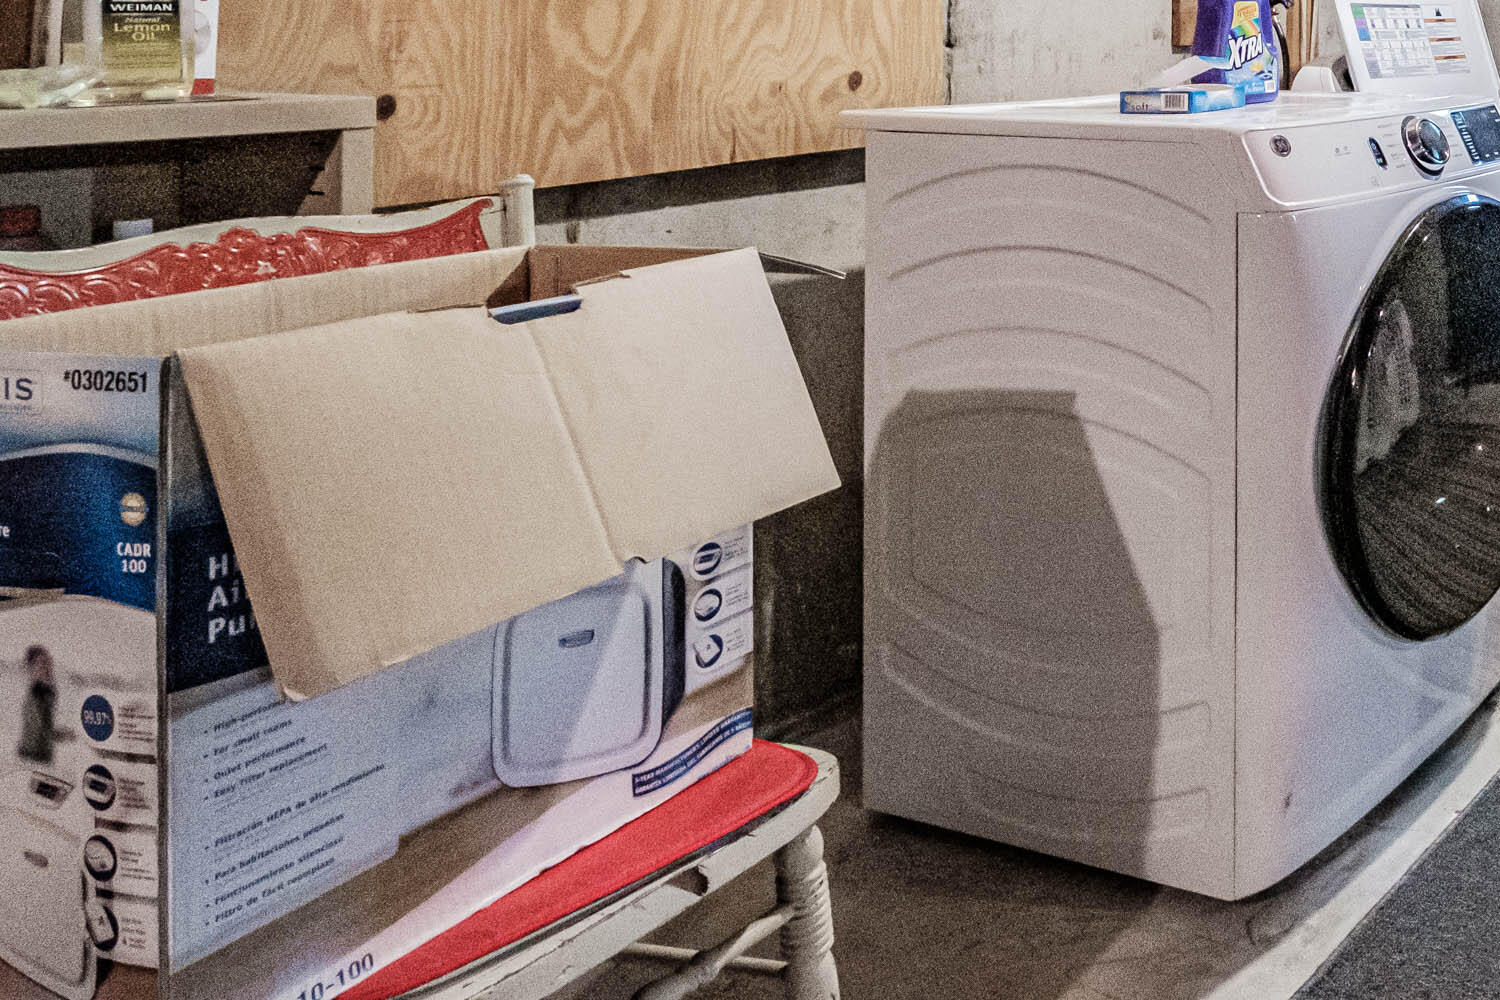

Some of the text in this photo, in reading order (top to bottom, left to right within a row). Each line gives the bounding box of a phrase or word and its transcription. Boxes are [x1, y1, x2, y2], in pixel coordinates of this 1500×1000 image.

[109, 3, 173, 12] WEIMAN
[113, 22, 171, 32] Lemon
[131, 31, 155, 41] Oil
[1228, 31, 1263, 70] XTRA
[64, 369, 148, 393] #0302651
[117, 542, 151, 558] CADR
[121, 559, 147, 574] 100
